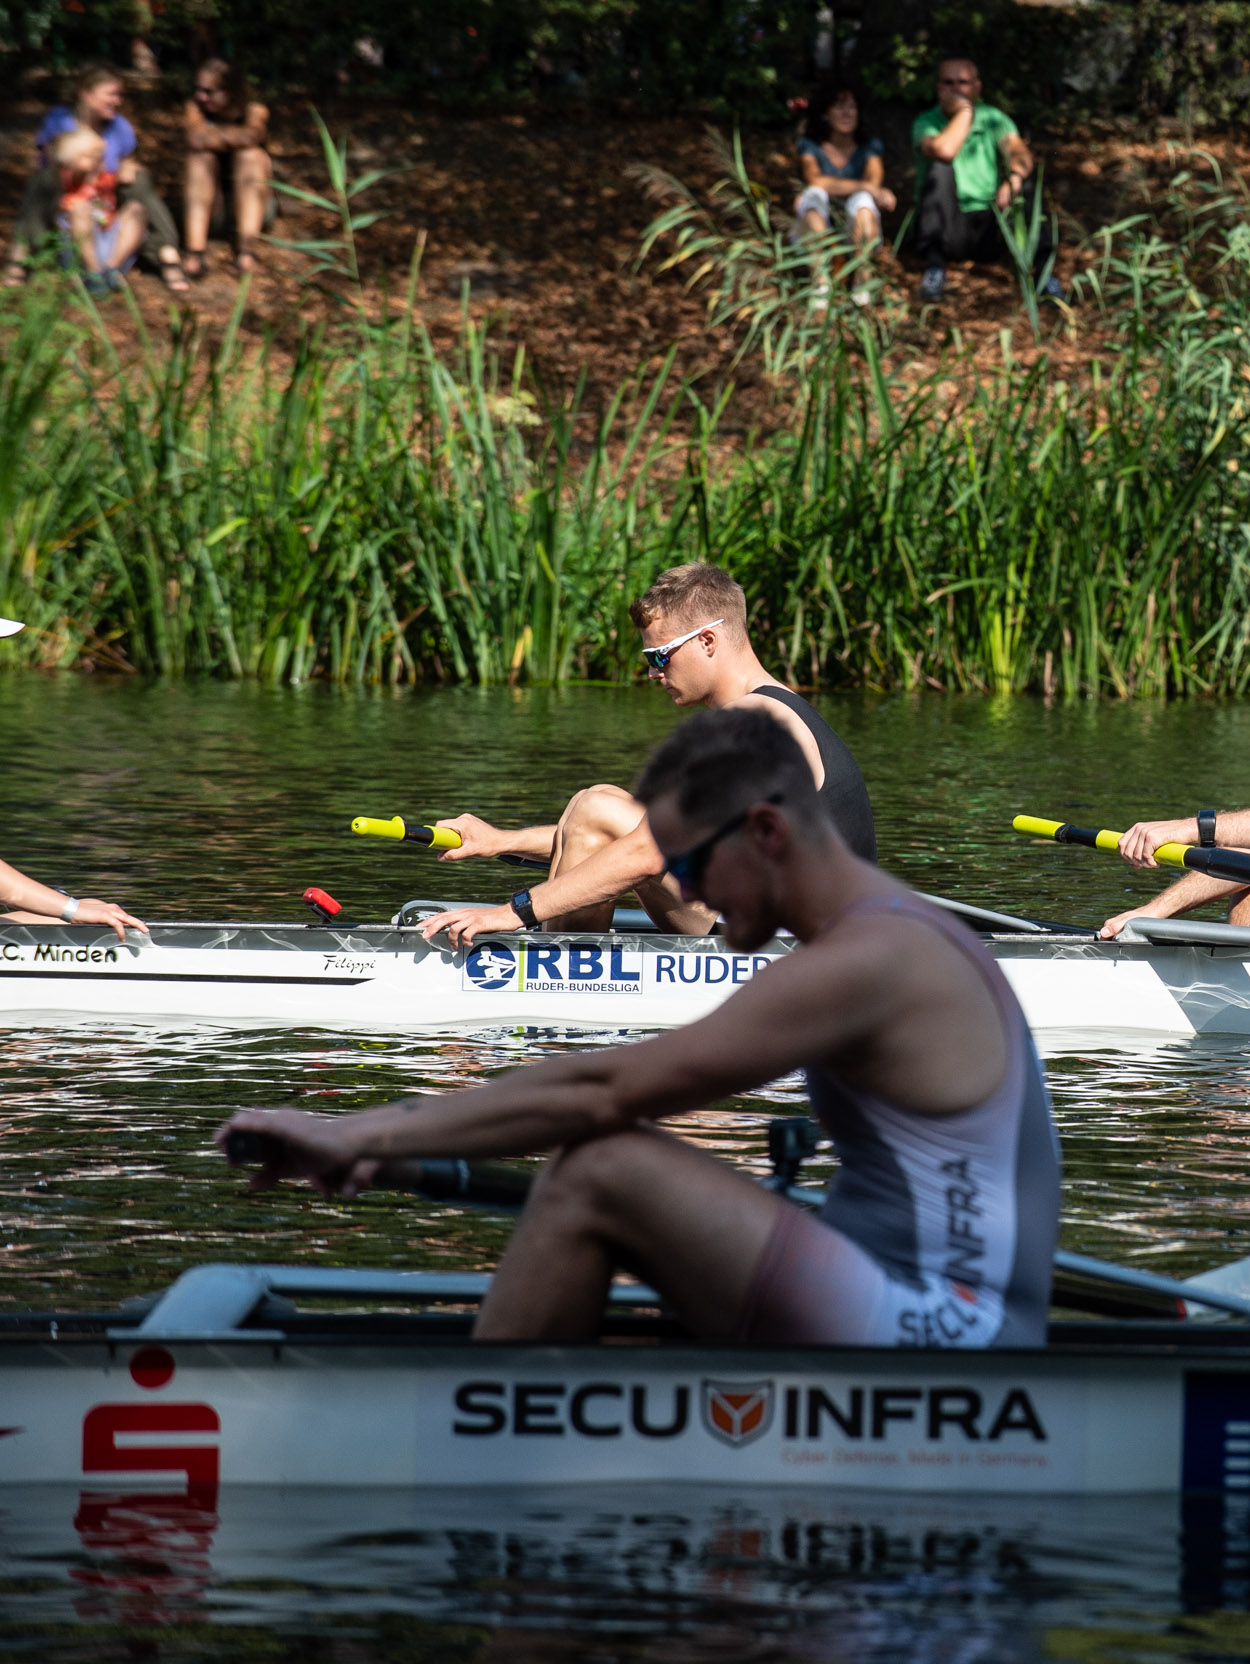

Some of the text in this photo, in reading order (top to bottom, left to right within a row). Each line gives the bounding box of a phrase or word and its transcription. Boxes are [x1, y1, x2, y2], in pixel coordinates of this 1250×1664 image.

[33, 942, 118, 963] Minden
[323, 953, 376, 973] Filippi
[527, 942, 641, 981] RBL
[526, 982, 640, 993] RUDER-BUNDESLIGA
[452, 1381, 1048, 1441] SECU INFRA
